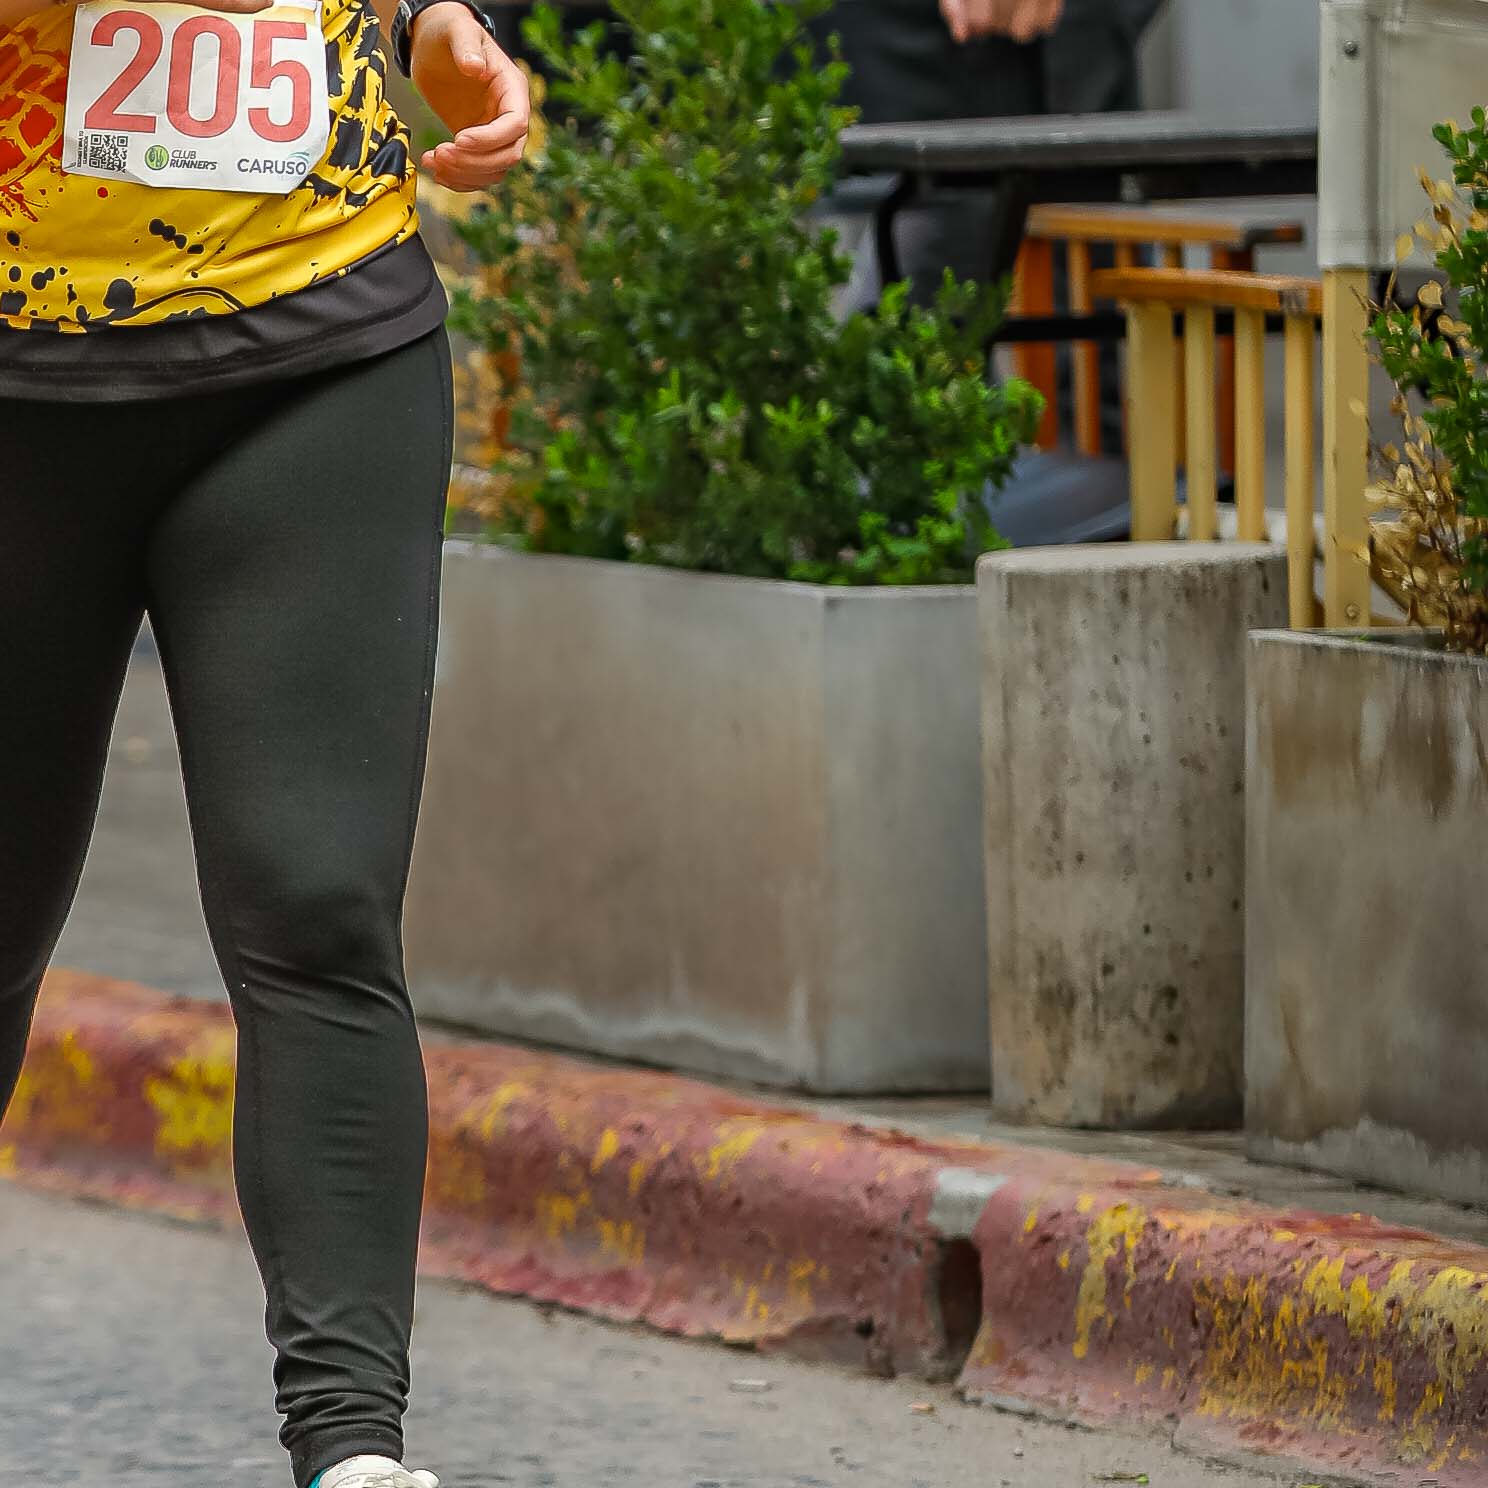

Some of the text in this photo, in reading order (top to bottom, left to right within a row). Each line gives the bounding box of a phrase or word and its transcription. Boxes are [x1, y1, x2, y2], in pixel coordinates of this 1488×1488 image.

[84, 10, 312, 143] 205
[171, 149, 197, 159] CLUB
[237, 158, 307, 175] CARUSO
